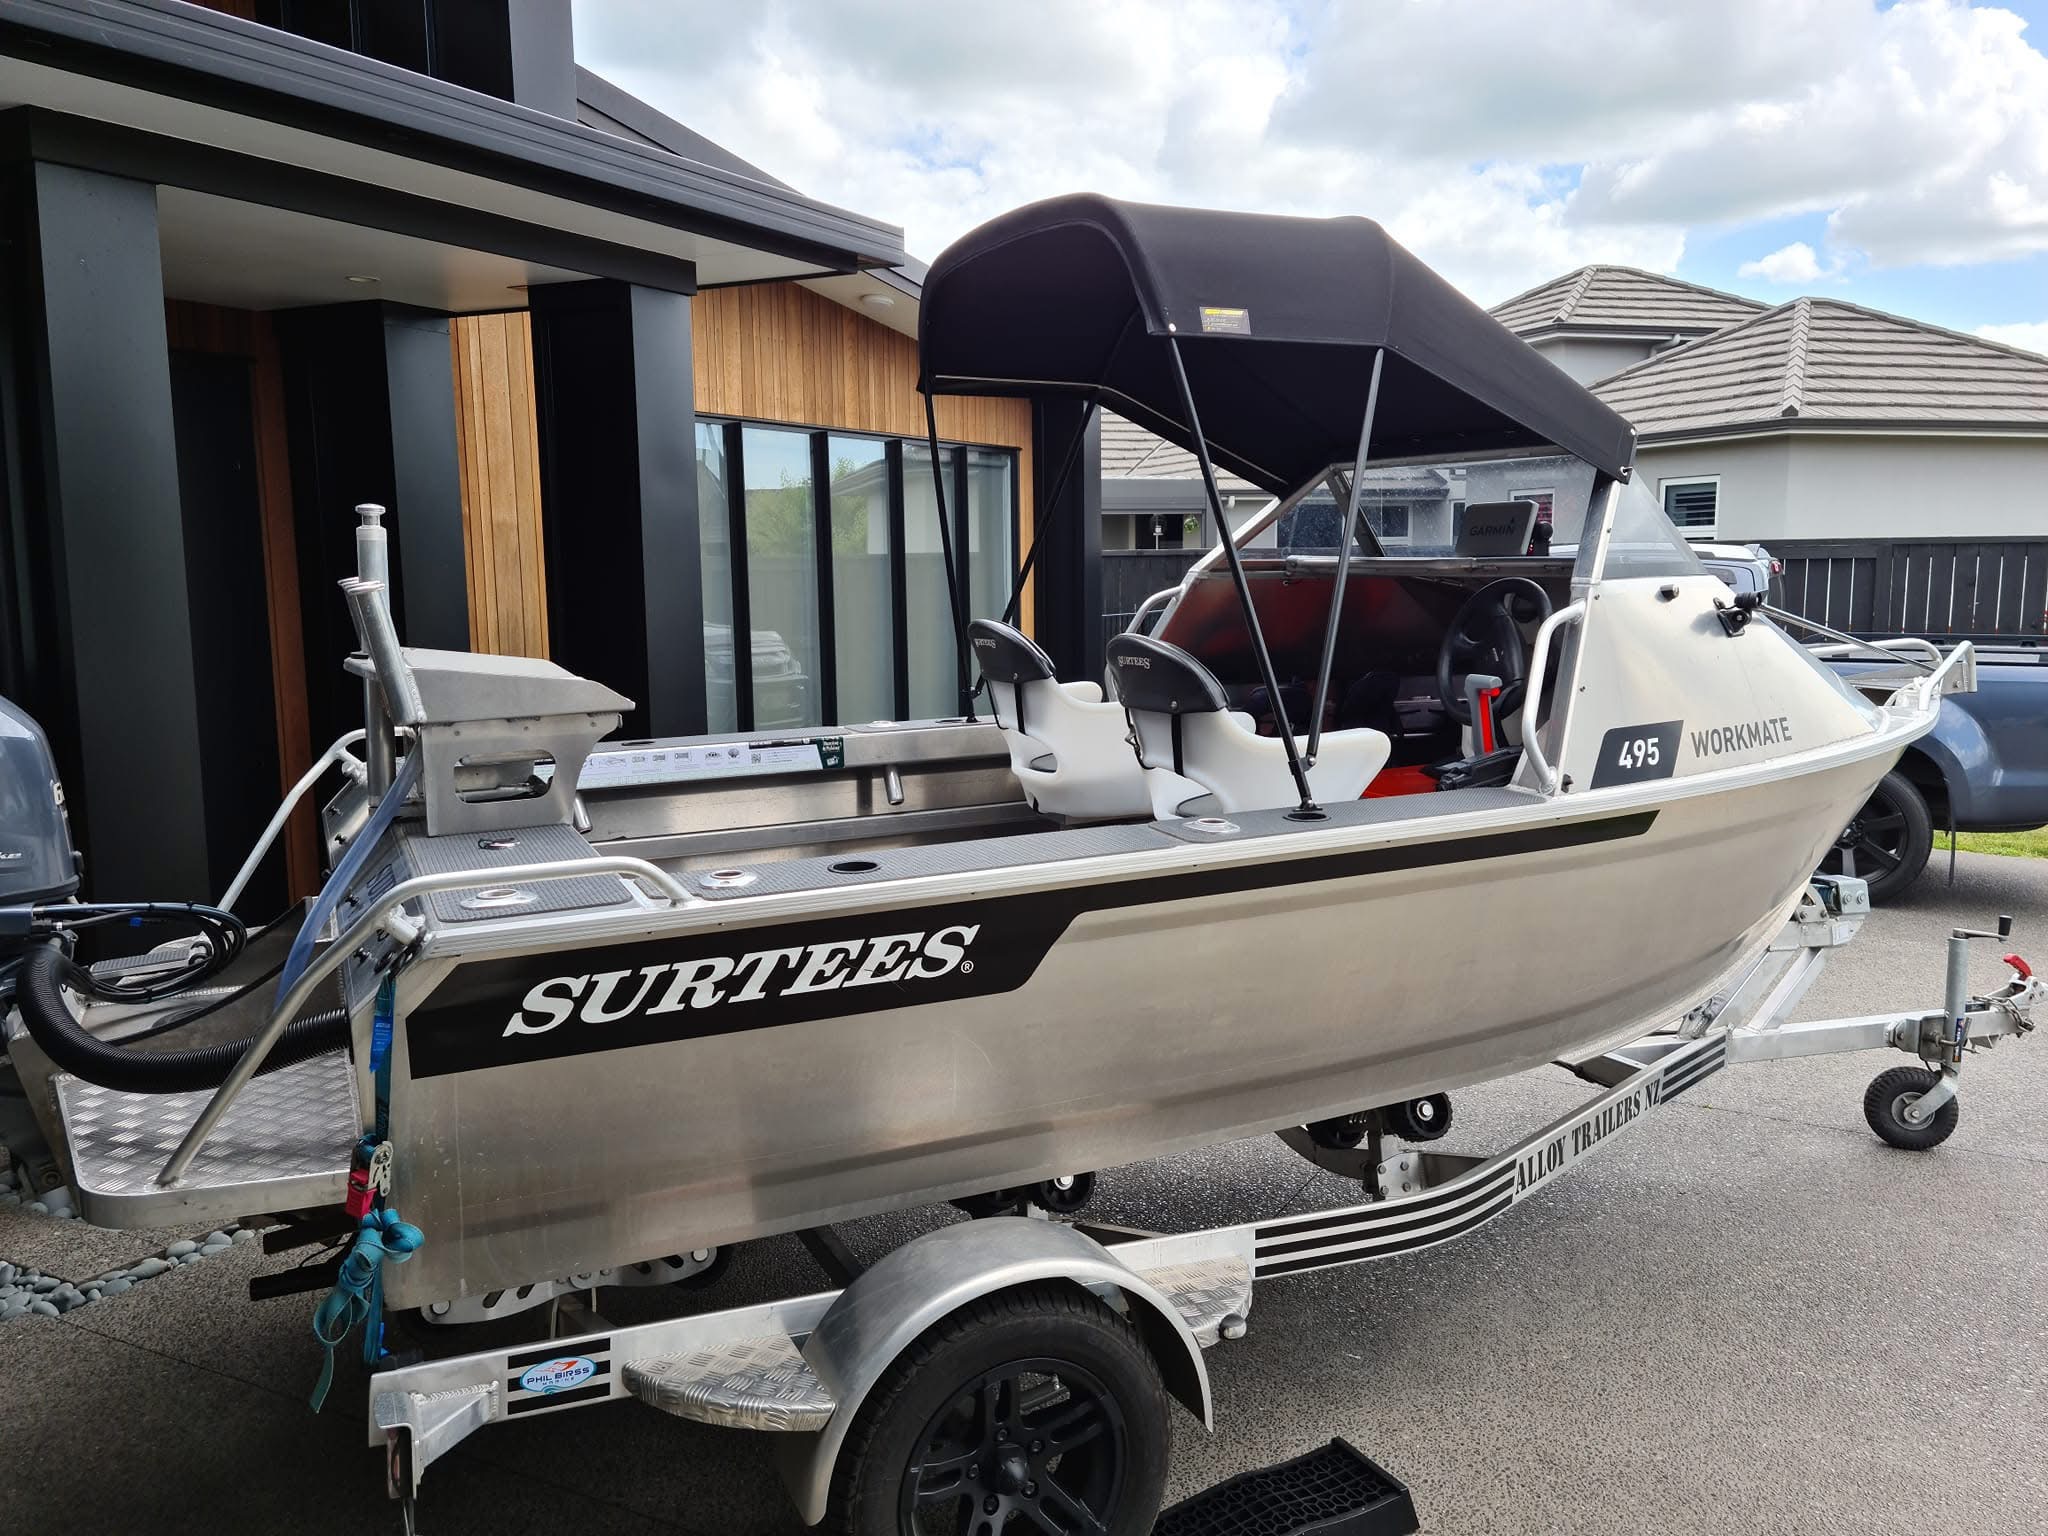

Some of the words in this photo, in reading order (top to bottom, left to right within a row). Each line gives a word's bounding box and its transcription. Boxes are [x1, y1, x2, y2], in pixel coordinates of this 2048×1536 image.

[1470, 524, 1516, 536] GARMIN
[1117, 655, 1151, 669] SURTEES
[1618, 737, 1660, 769] 495
[1691, 717, 1792, 758] WORKMATE
[1515, 1135, 1566, 1195] ALLOY
[1571, 1090, 1641, 1157] TRAILERS
[1644, 1078, 1661, 1111] NZ
[527, 1375, 552, 1385] PHIL
[555, 1366, 590, 1379] BIRSS
